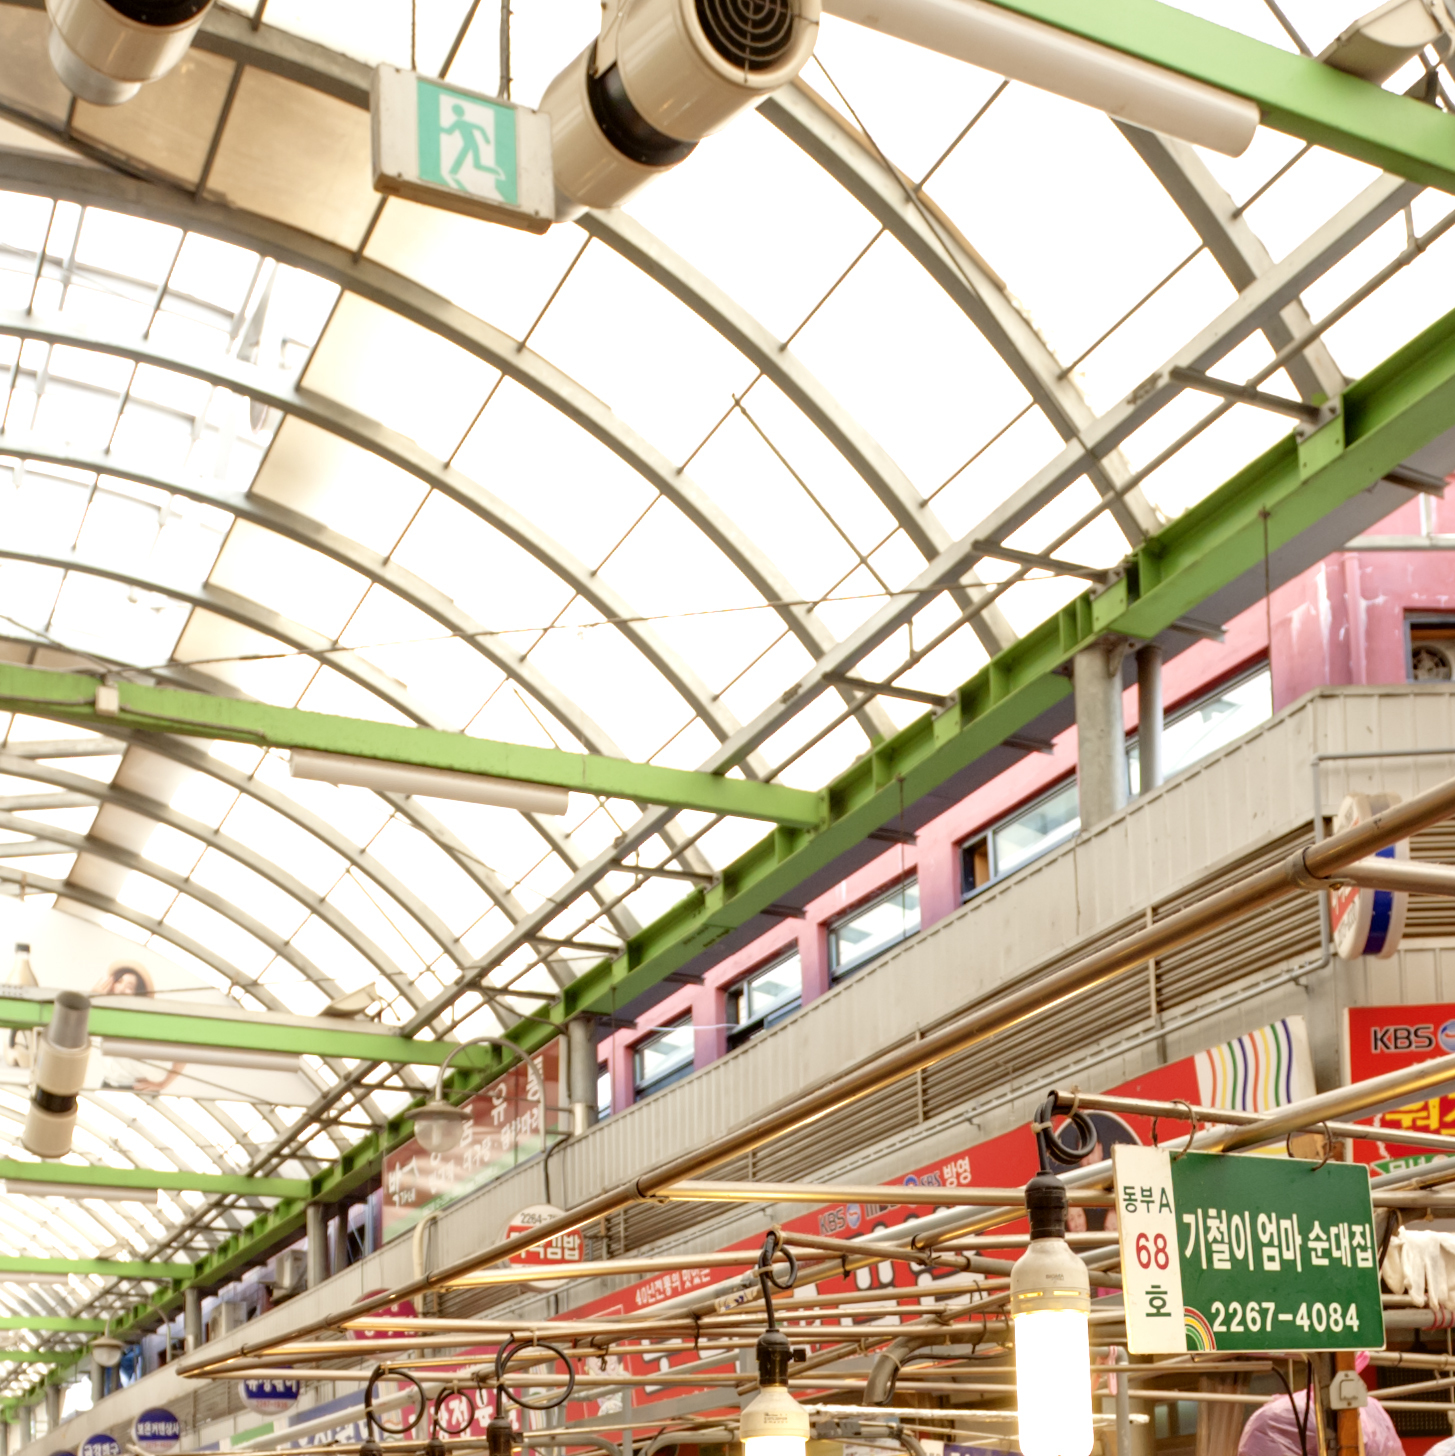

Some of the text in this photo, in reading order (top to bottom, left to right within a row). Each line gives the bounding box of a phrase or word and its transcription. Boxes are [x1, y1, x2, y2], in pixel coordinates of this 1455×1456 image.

[1371, 1025, 1436, 1053] KBS
[943, 1156, 972, 1188] 방영
[818, 1207, 847, 1236] KBS
[1135, 1231, 1170, 1271] 68
[1182, 1207, 1373, 1273] 기철이 엄마 순대집
[1144, 1284, 1172, 1318] 호
[1211, 1301, 1360, 1333] 2267-4084
